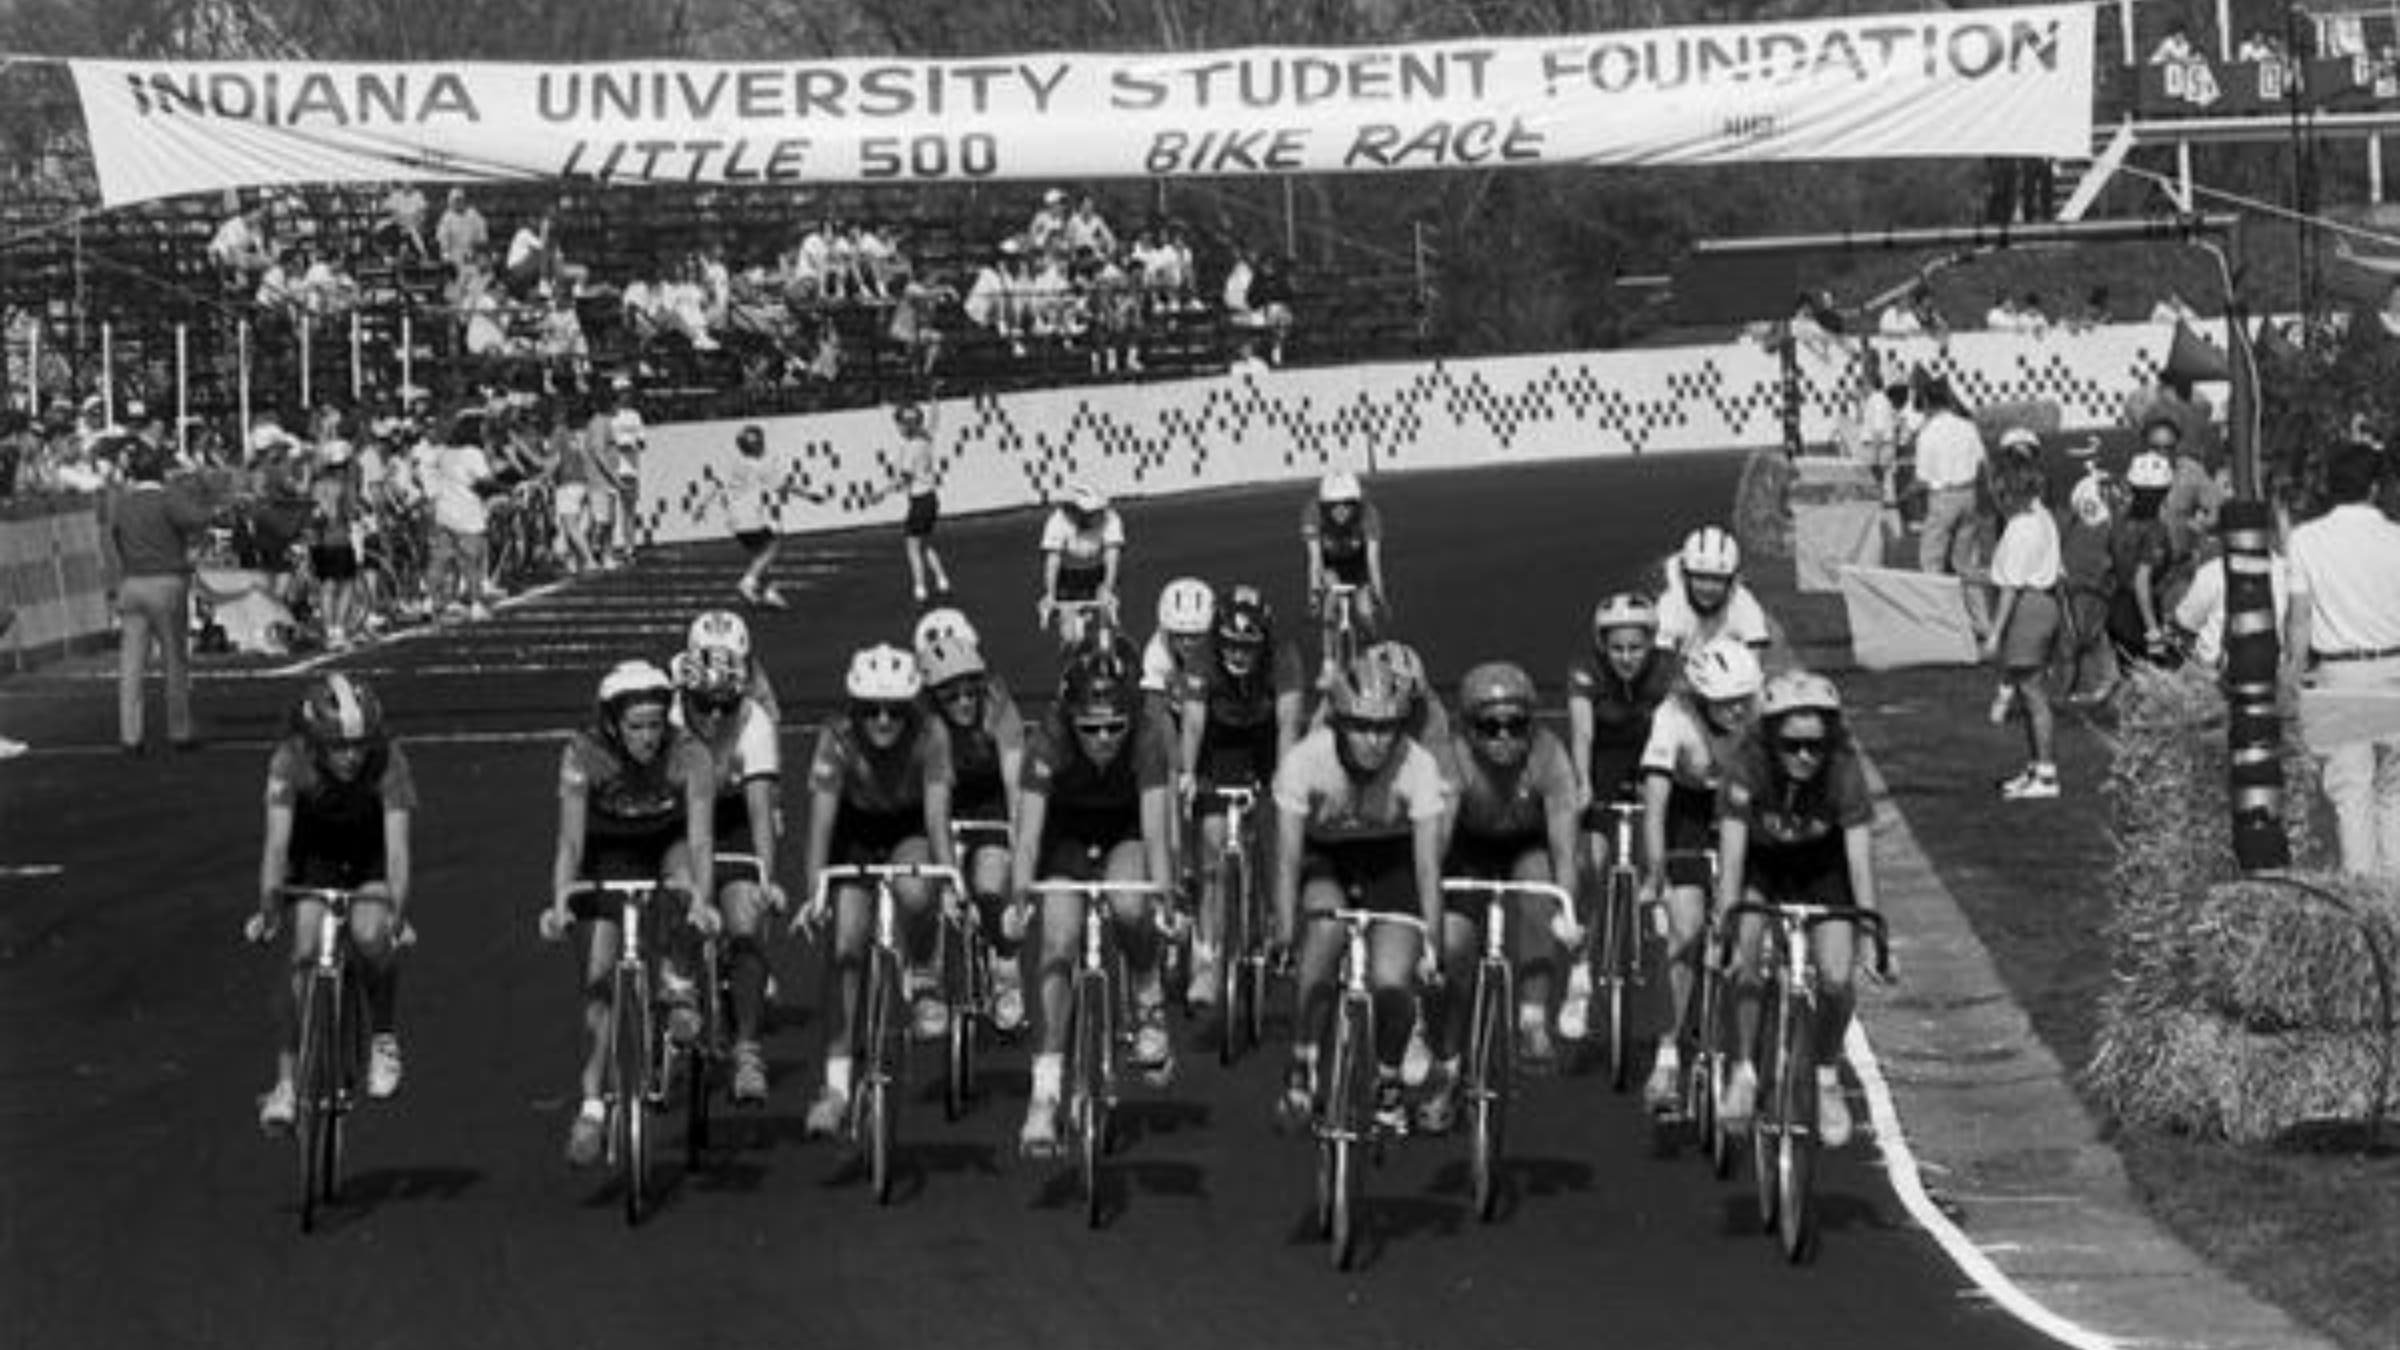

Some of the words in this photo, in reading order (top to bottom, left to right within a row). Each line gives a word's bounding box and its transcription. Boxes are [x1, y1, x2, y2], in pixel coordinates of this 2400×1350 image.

[127, 72, 481, 126] INDIANA
[537, 63, 1071, 121] UNIVERSITY
[1110, 49, 1495, 109] STUDENT
[1542, 19, 2060, 97] FOUNDATION
[562, 138, 811, 183] LITTLE
[859, 133, 998, 179] 500
[1145, 128, 1312, 175] BIKE
[1344, 115, 1546, 167] RACE
